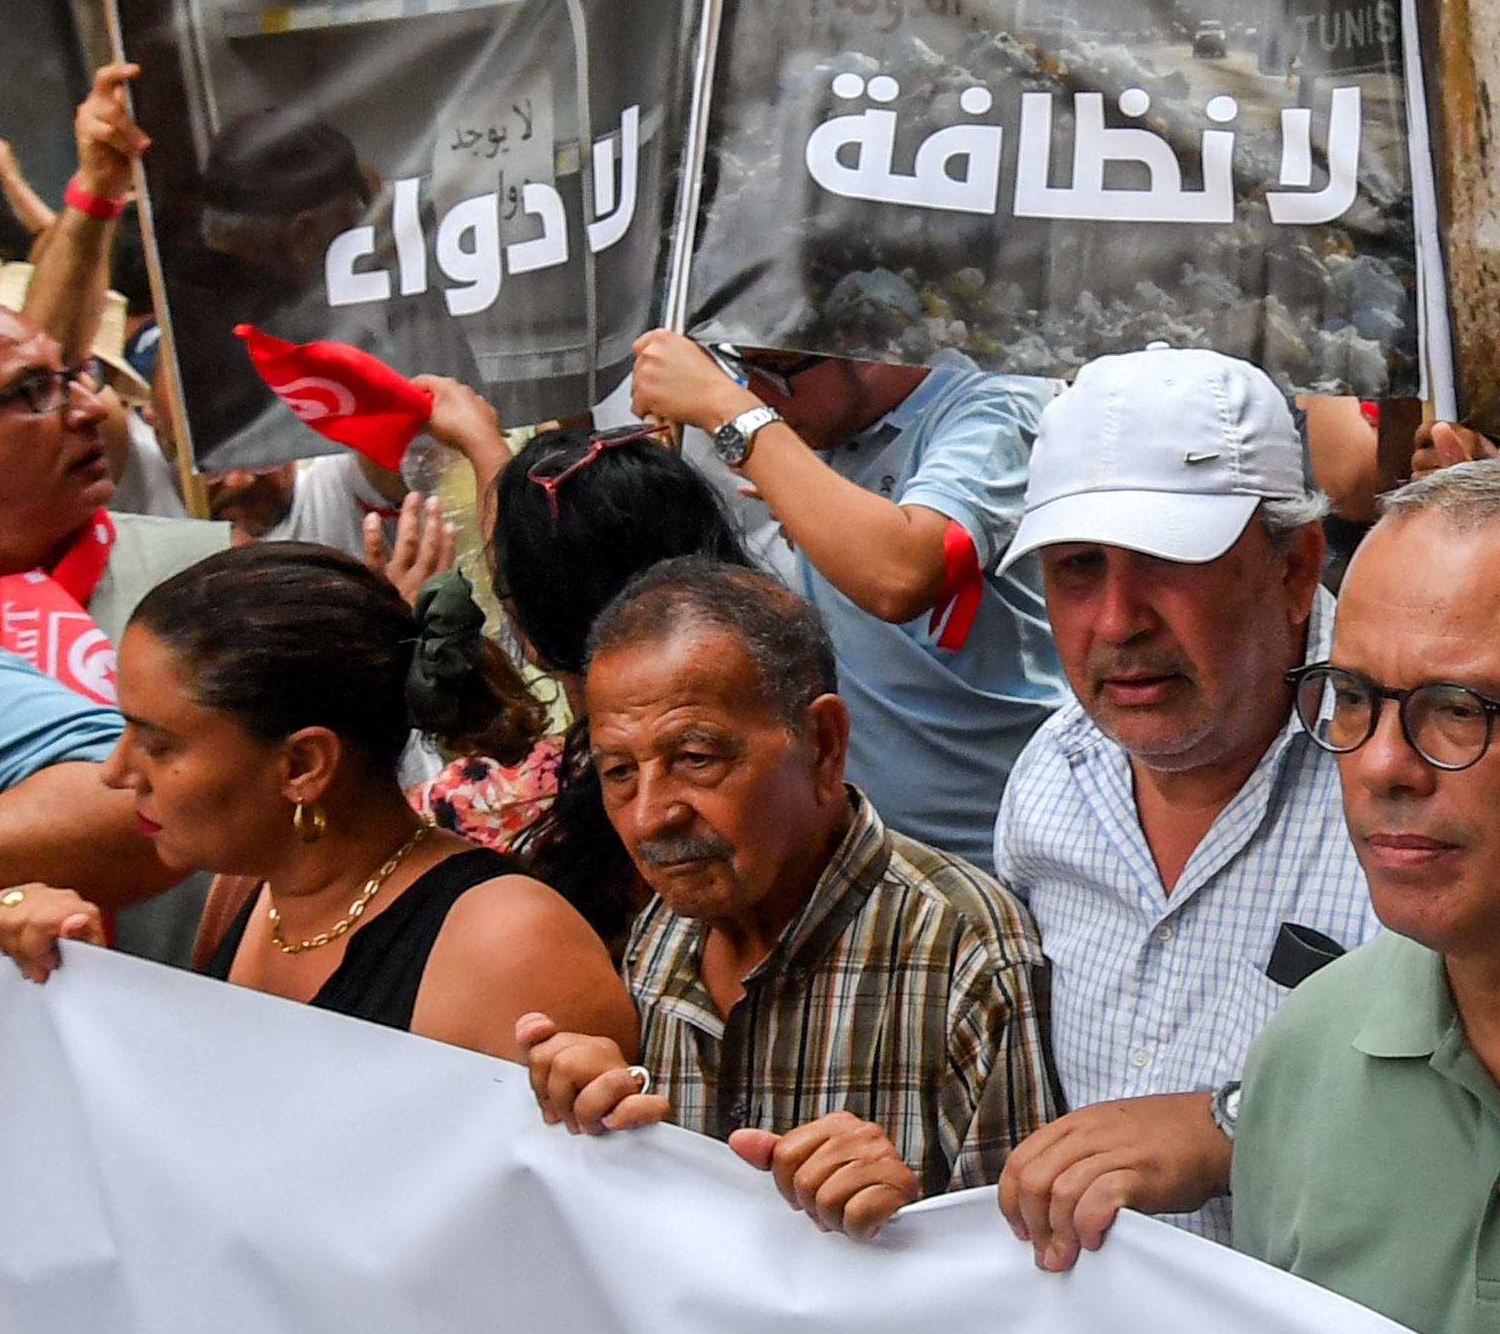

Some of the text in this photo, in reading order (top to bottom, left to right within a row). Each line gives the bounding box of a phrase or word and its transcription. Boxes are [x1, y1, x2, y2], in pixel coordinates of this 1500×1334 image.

[1297, 2, 1396, 52] TUNIS
[324, 104, 640, 317] لا دواء
[805, 70, 1363, 223] لا نظافة
